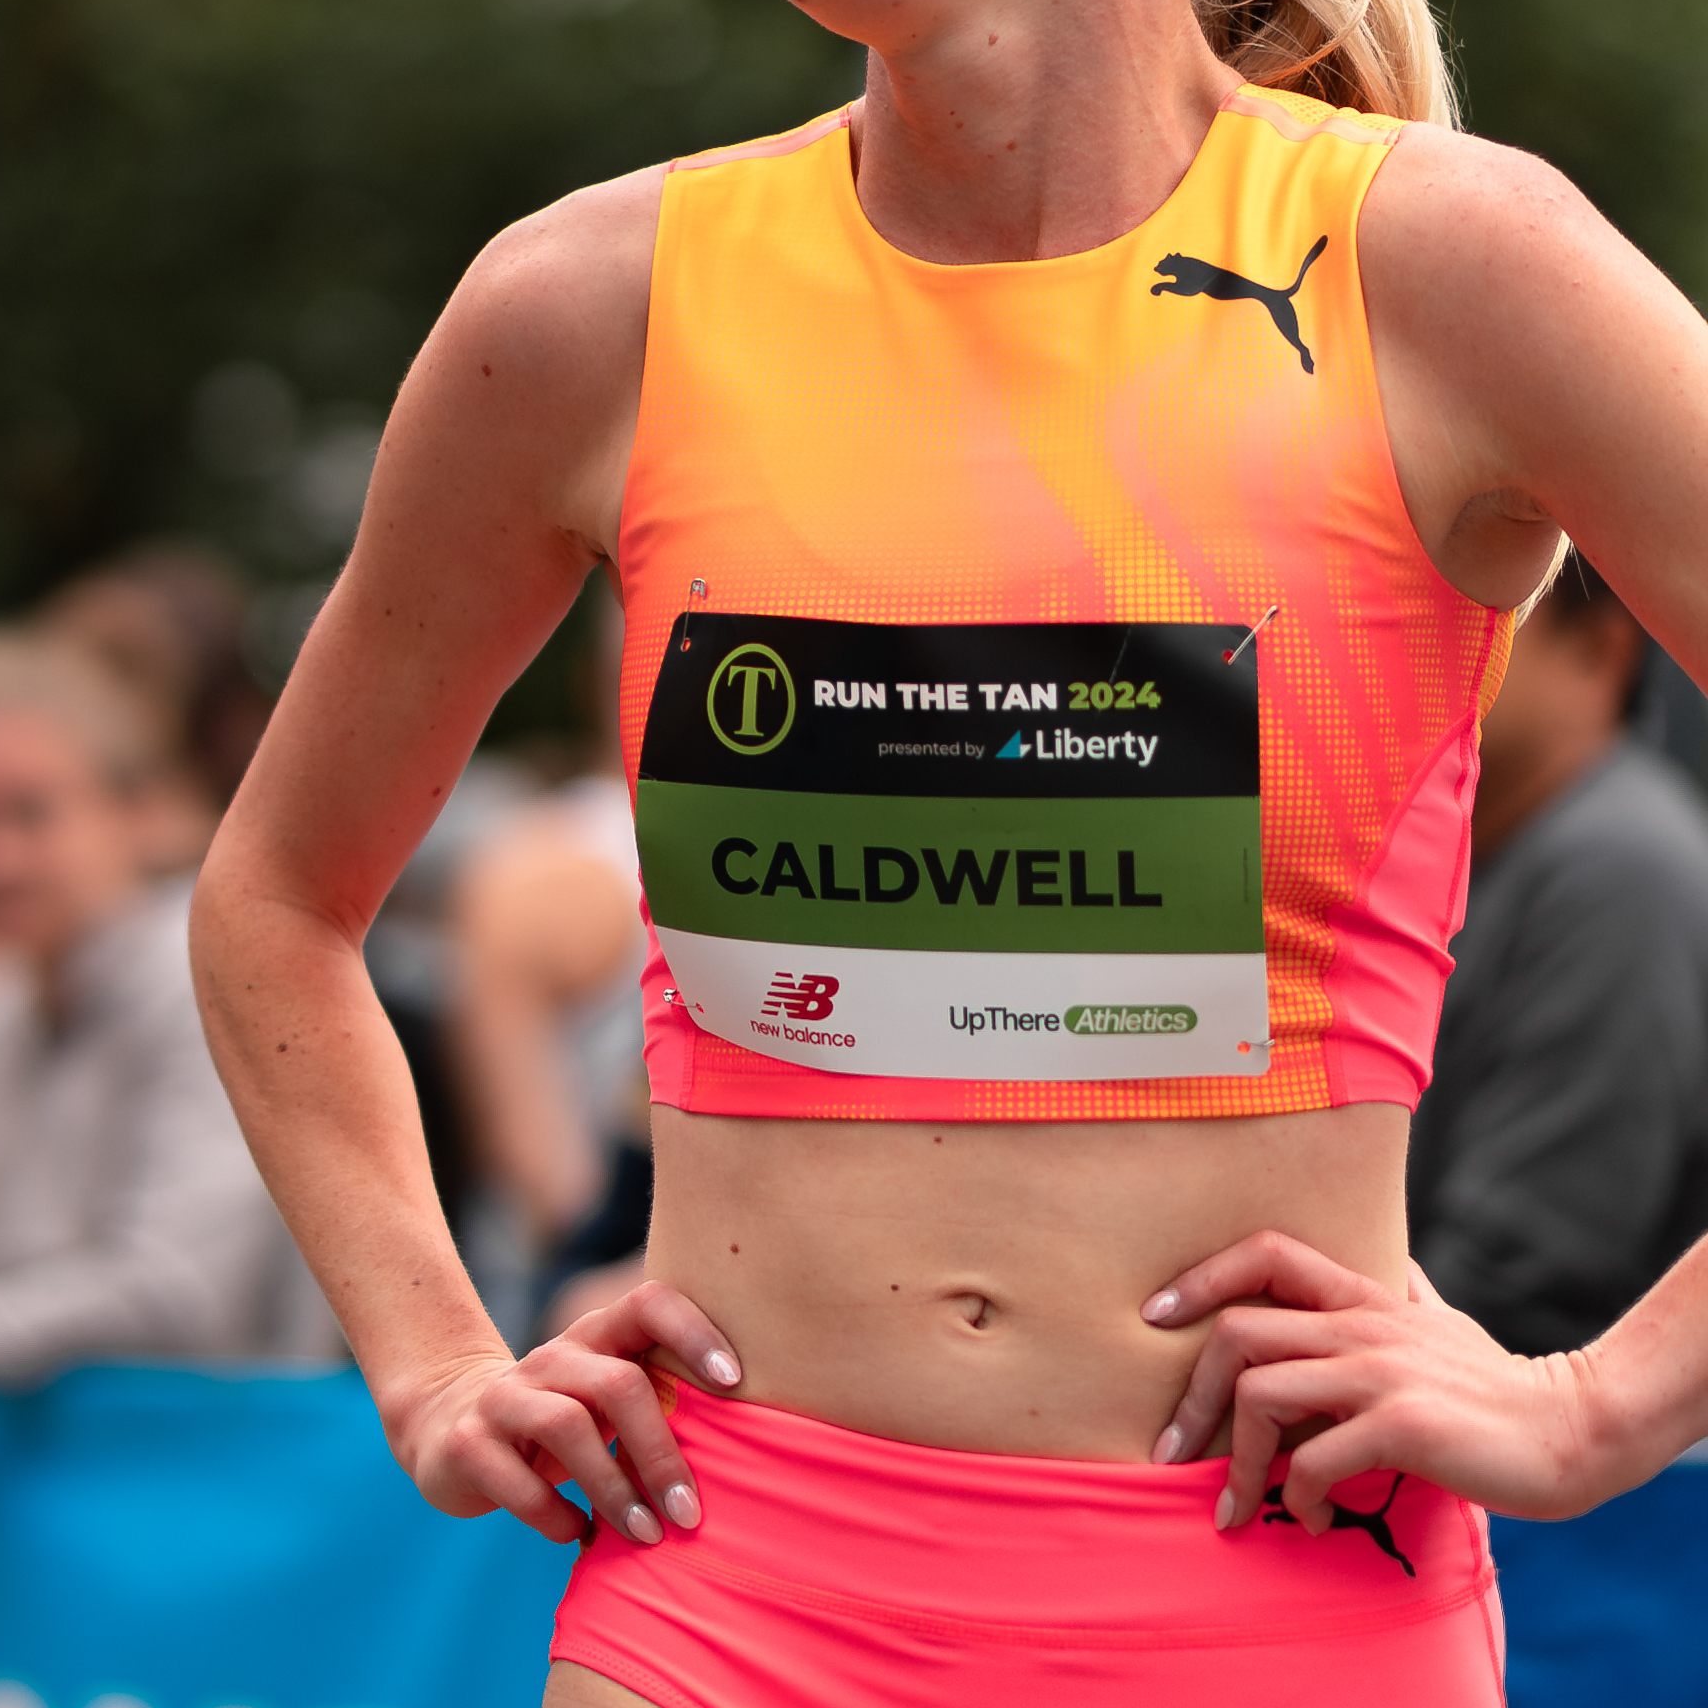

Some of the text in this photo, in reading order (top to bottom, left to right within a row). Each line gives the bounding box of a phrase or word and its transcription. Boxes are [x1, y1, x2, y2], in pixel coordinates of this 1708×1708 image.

[814, 680, 1162, 710] RUN THE TAN 2024
[878, 728, 1159, 767] presented by Liberty
[711, 837, 1162, 908] CALDWELL
[750, 1018, 856, 1048] new balance
[949, 1006, 1189, 1036] UpThere Athletics
